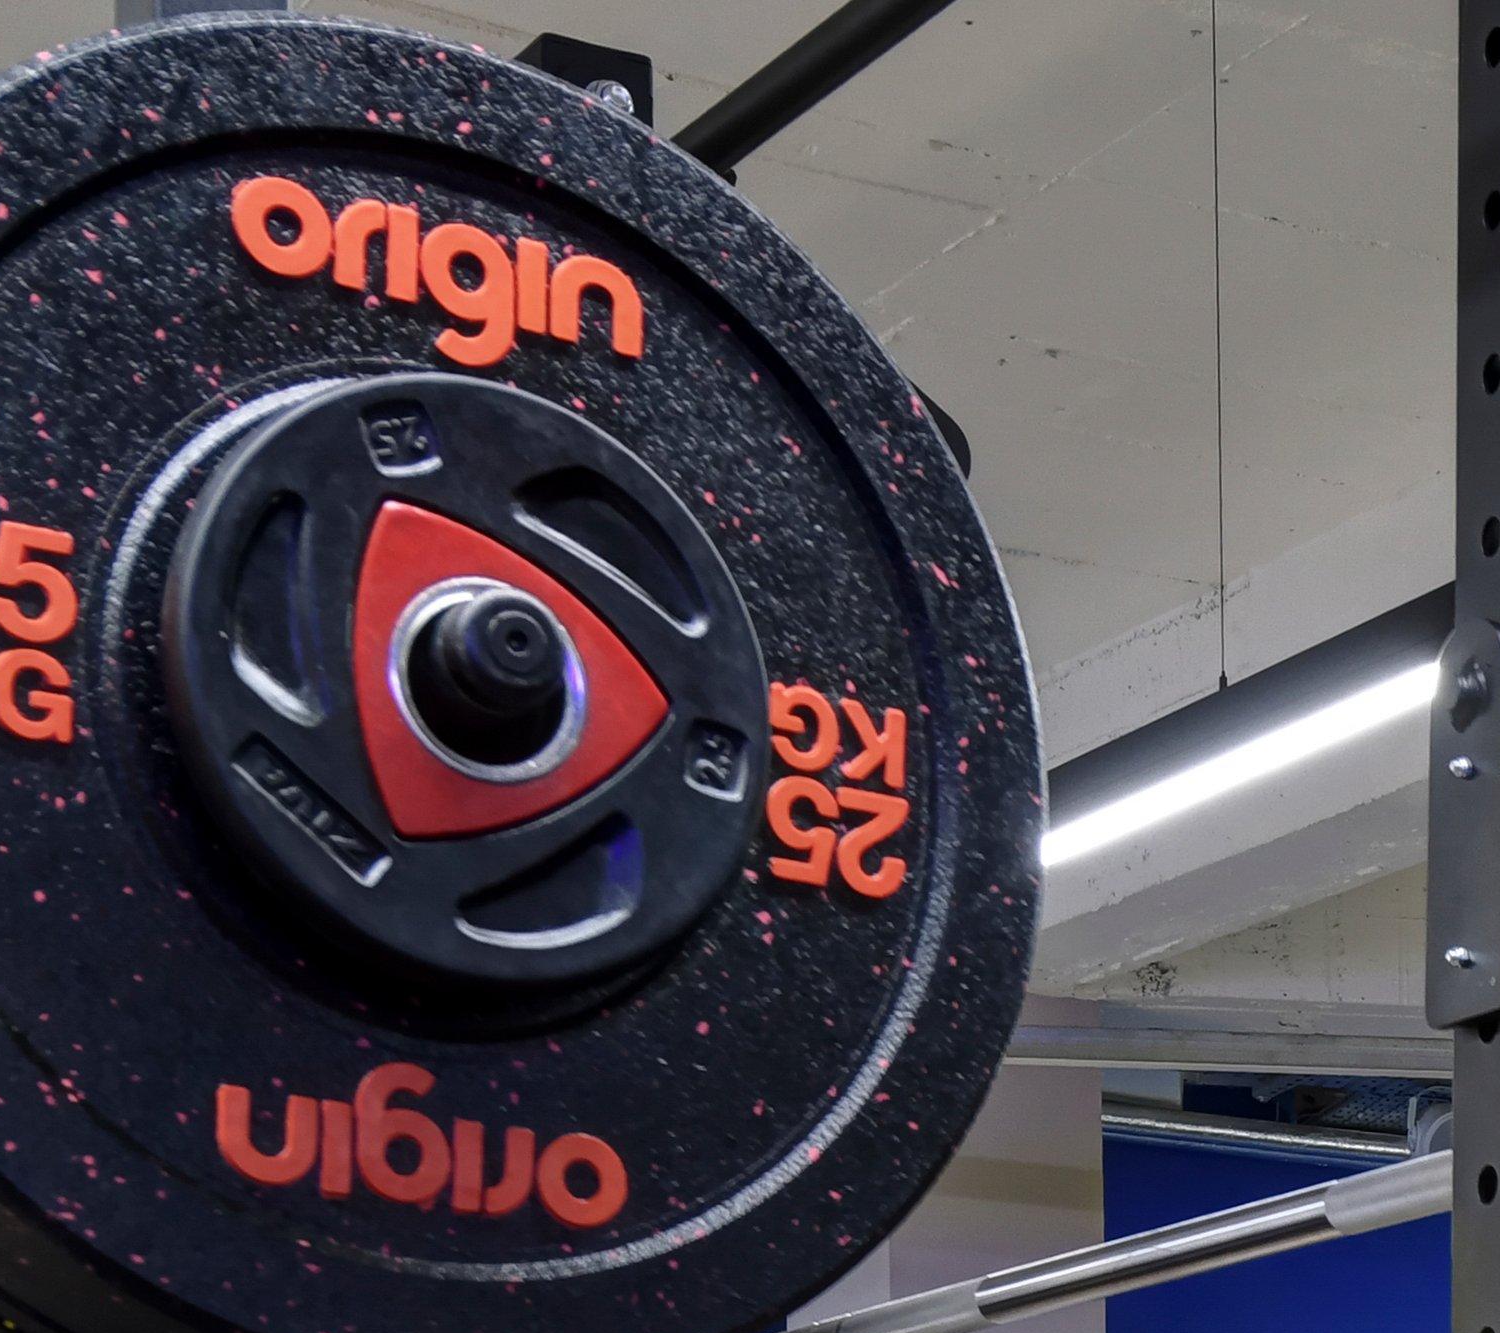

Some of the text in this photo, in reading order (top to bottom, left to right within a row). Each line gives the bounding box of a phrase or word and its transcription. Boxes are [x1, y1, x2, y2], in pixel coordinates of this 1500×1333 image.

[231, 175, 644, 365] origin
[769, 682, 906, 783] KG
[765, 777, 910, 898] 25
[215, 1062, 628, 1228] origin
